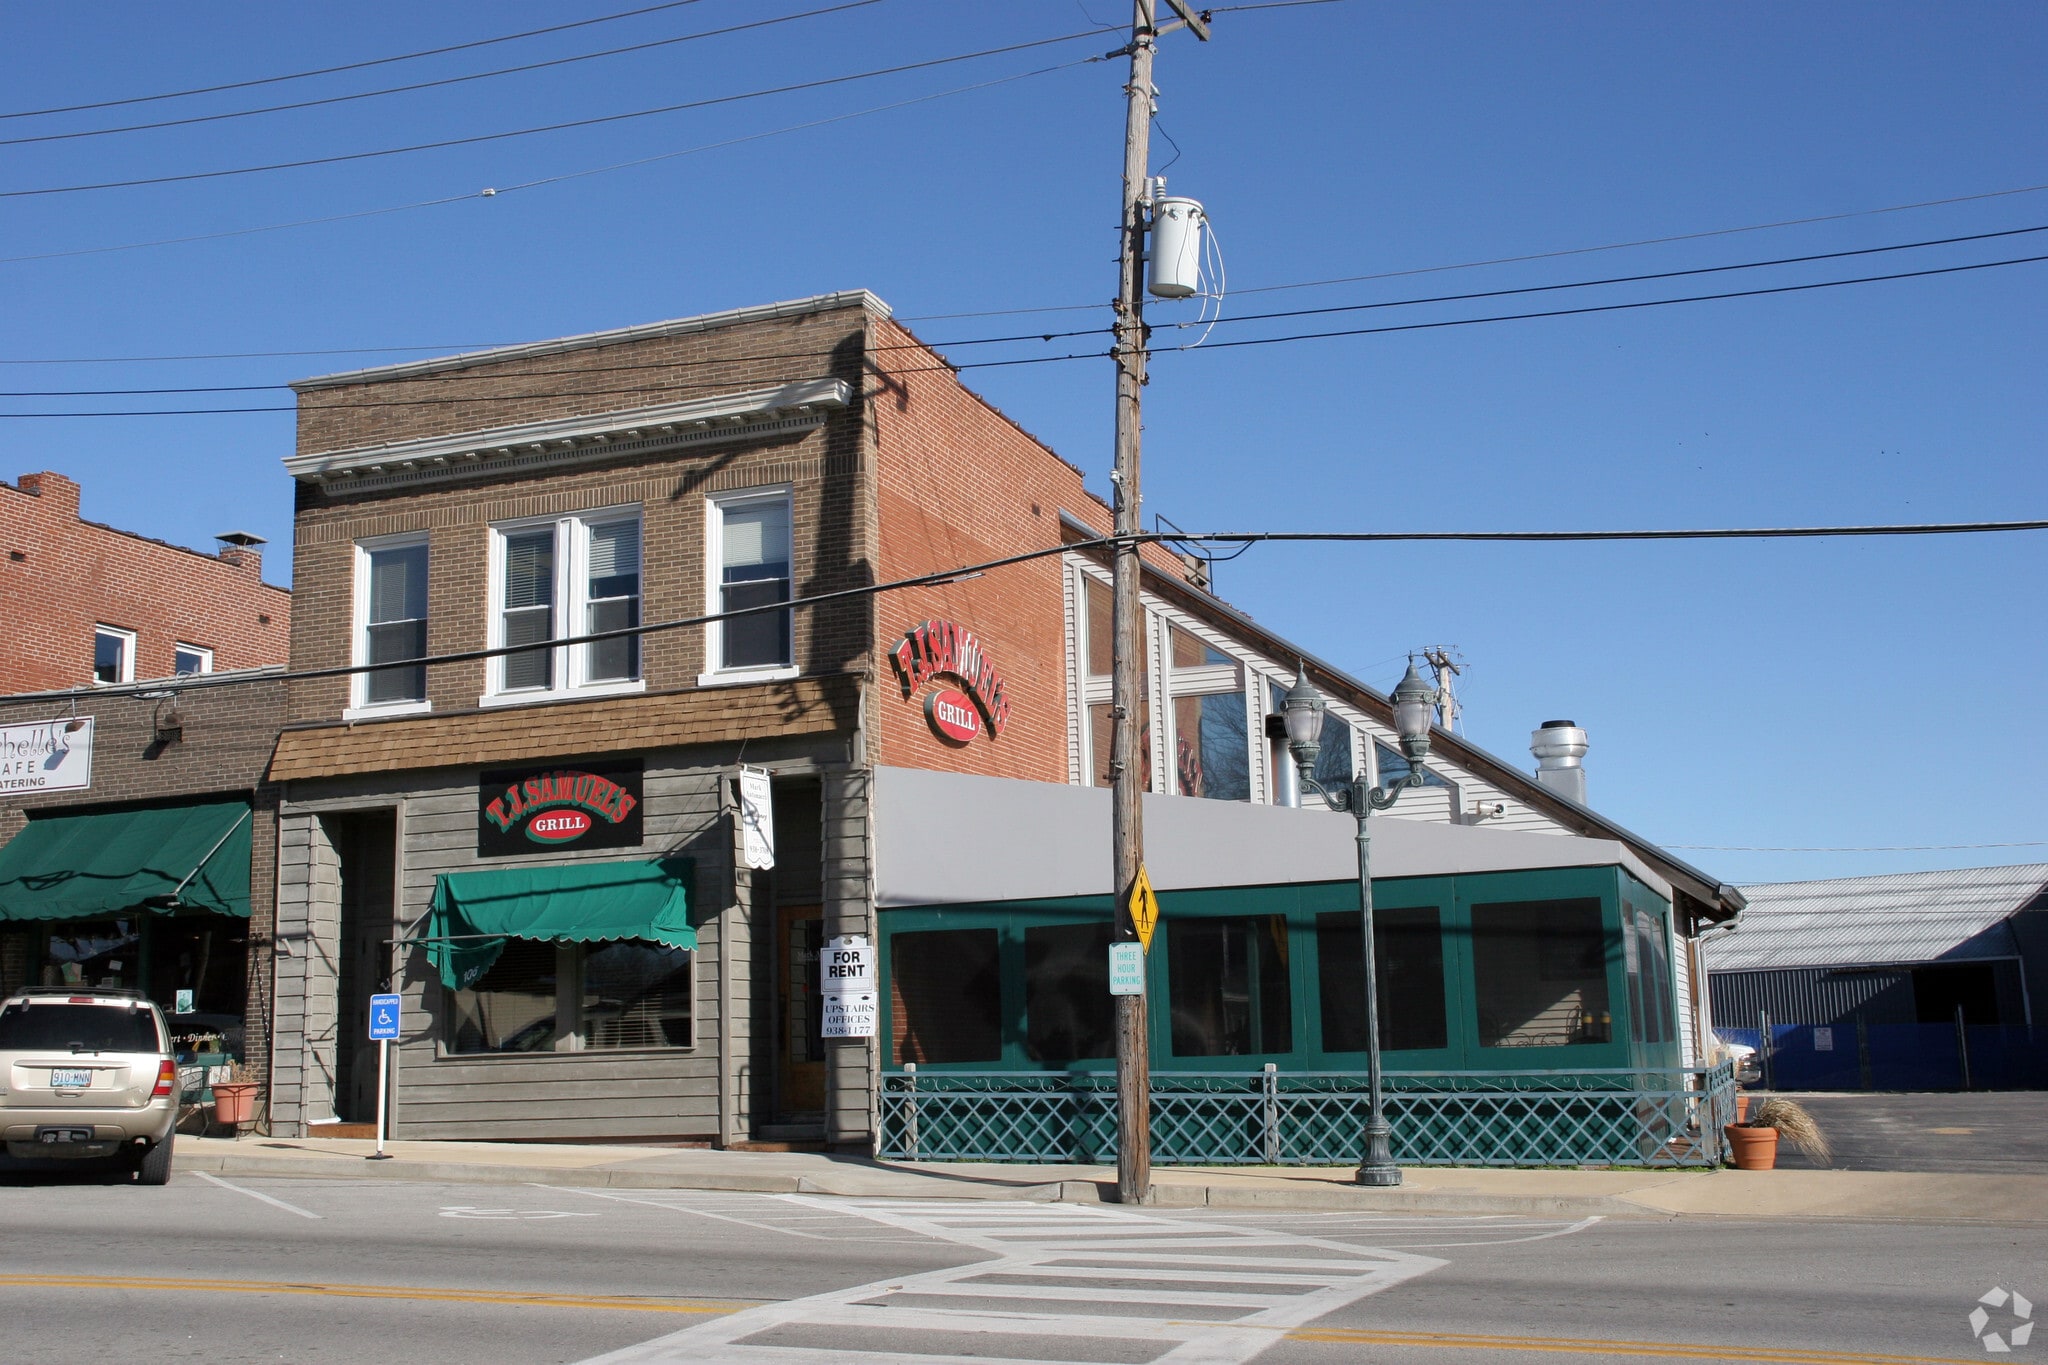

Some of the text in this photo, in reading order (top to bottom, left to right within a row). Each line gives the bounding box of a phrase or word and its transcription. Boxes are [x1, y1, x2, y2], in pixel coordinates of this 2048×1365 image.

[938, 701, 976, 731] GRILL
[0, 728, 70, 759] helle's
[2, 760, 35, 776] AFE
[0, 777, 46, 790] ATERING
[535, 816, 585, 832] GRILL
[833, 951, 860, 964] FOR
[1116, 951, 1136, 961] THREE
[829, 964, 865, 978] RENT
[1117, 963, 1136, 973] HOUR
[1113, 975, 1141, 985] PARKING
[825, 1003, 875, 1014] UPSTAIRS
[828, 1014, 871, 1025] OFFICES
[373, 1027, 395, 1035] PARKING
[826, 1026, 871, 1036] 938-1177
